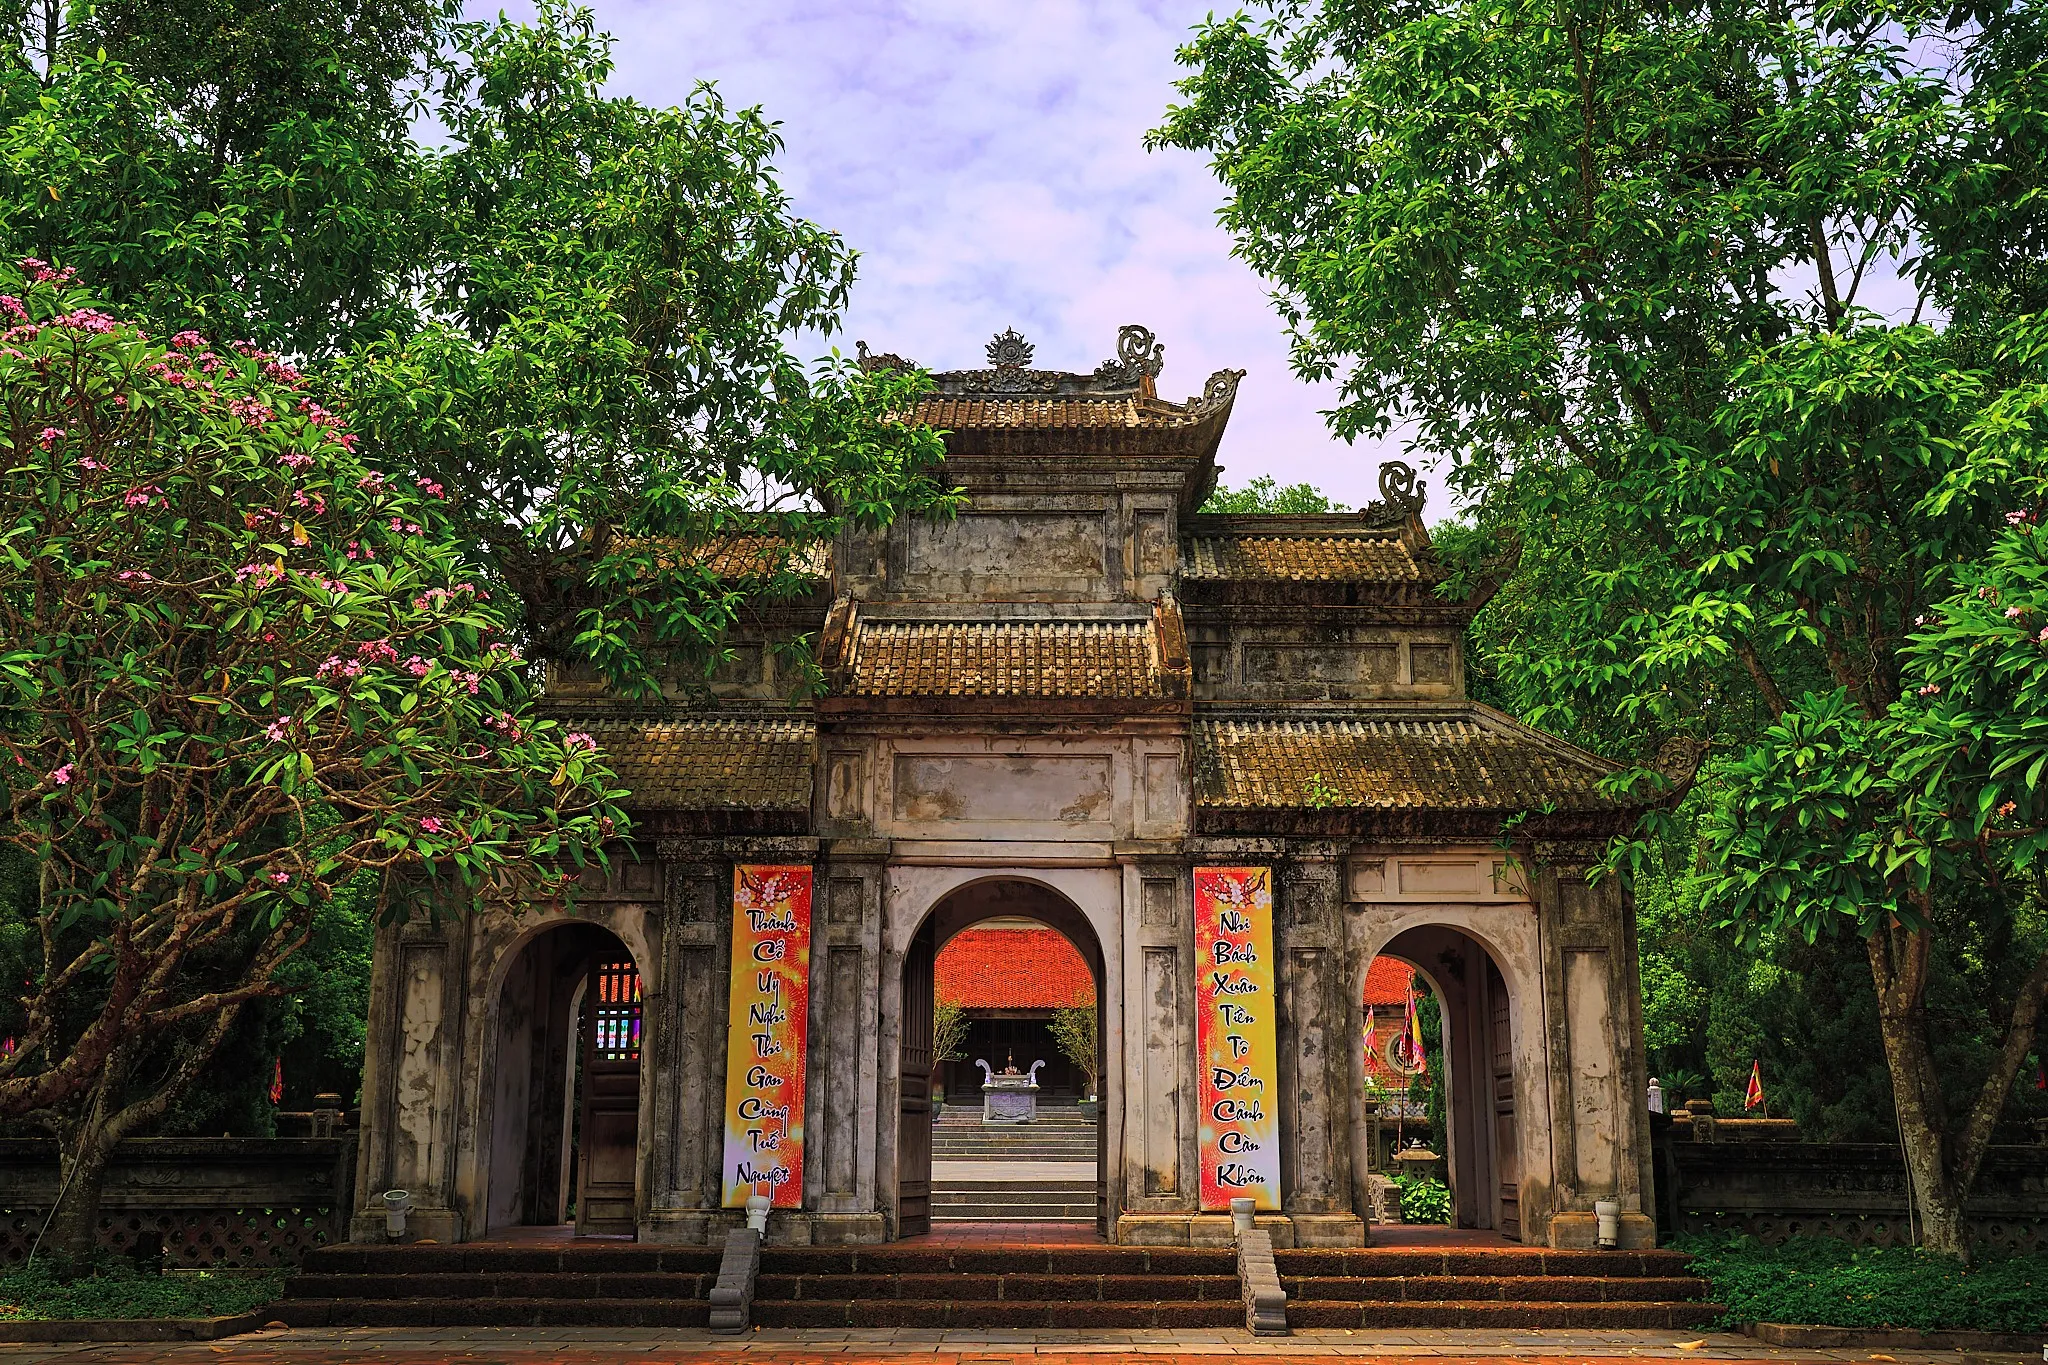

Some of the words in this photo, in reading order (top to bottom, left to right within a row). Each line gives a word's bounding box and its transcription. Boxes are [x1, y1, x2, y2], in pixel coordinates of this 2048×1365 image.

[746, 910, 796, 932] Thành
[1219, 911, 1251, 934] Nhị
[753, 940, 785, 962] Cổ
[1214, 941, 1257, 964] Bách
[758, 972, 780, 1007] Uy
[1213, 972, 1259, 995] Xuân
[749, 1002, 786, 1037] Nghi
[1219, 1004, 1256, 1027] Tiền
[752, 1034, 782, 1057] Thi
[1227, 1035, 1249, 1059] Tô
[746, 1066, 783, 1088] Gan
[1212, 1067, 1264, 1092] Điểm
[738, 1099, 788, 1137] Cùng
[1213, 1100, 1264, 1122] Cảnh
[747, 1130, 779, 1152] Tuế
[1219, 1132, 1261, 1154] Càn
[736, 1162, 790, 1199] Nguyệt
[1216, 1163, 1266, 1187] Khôn
